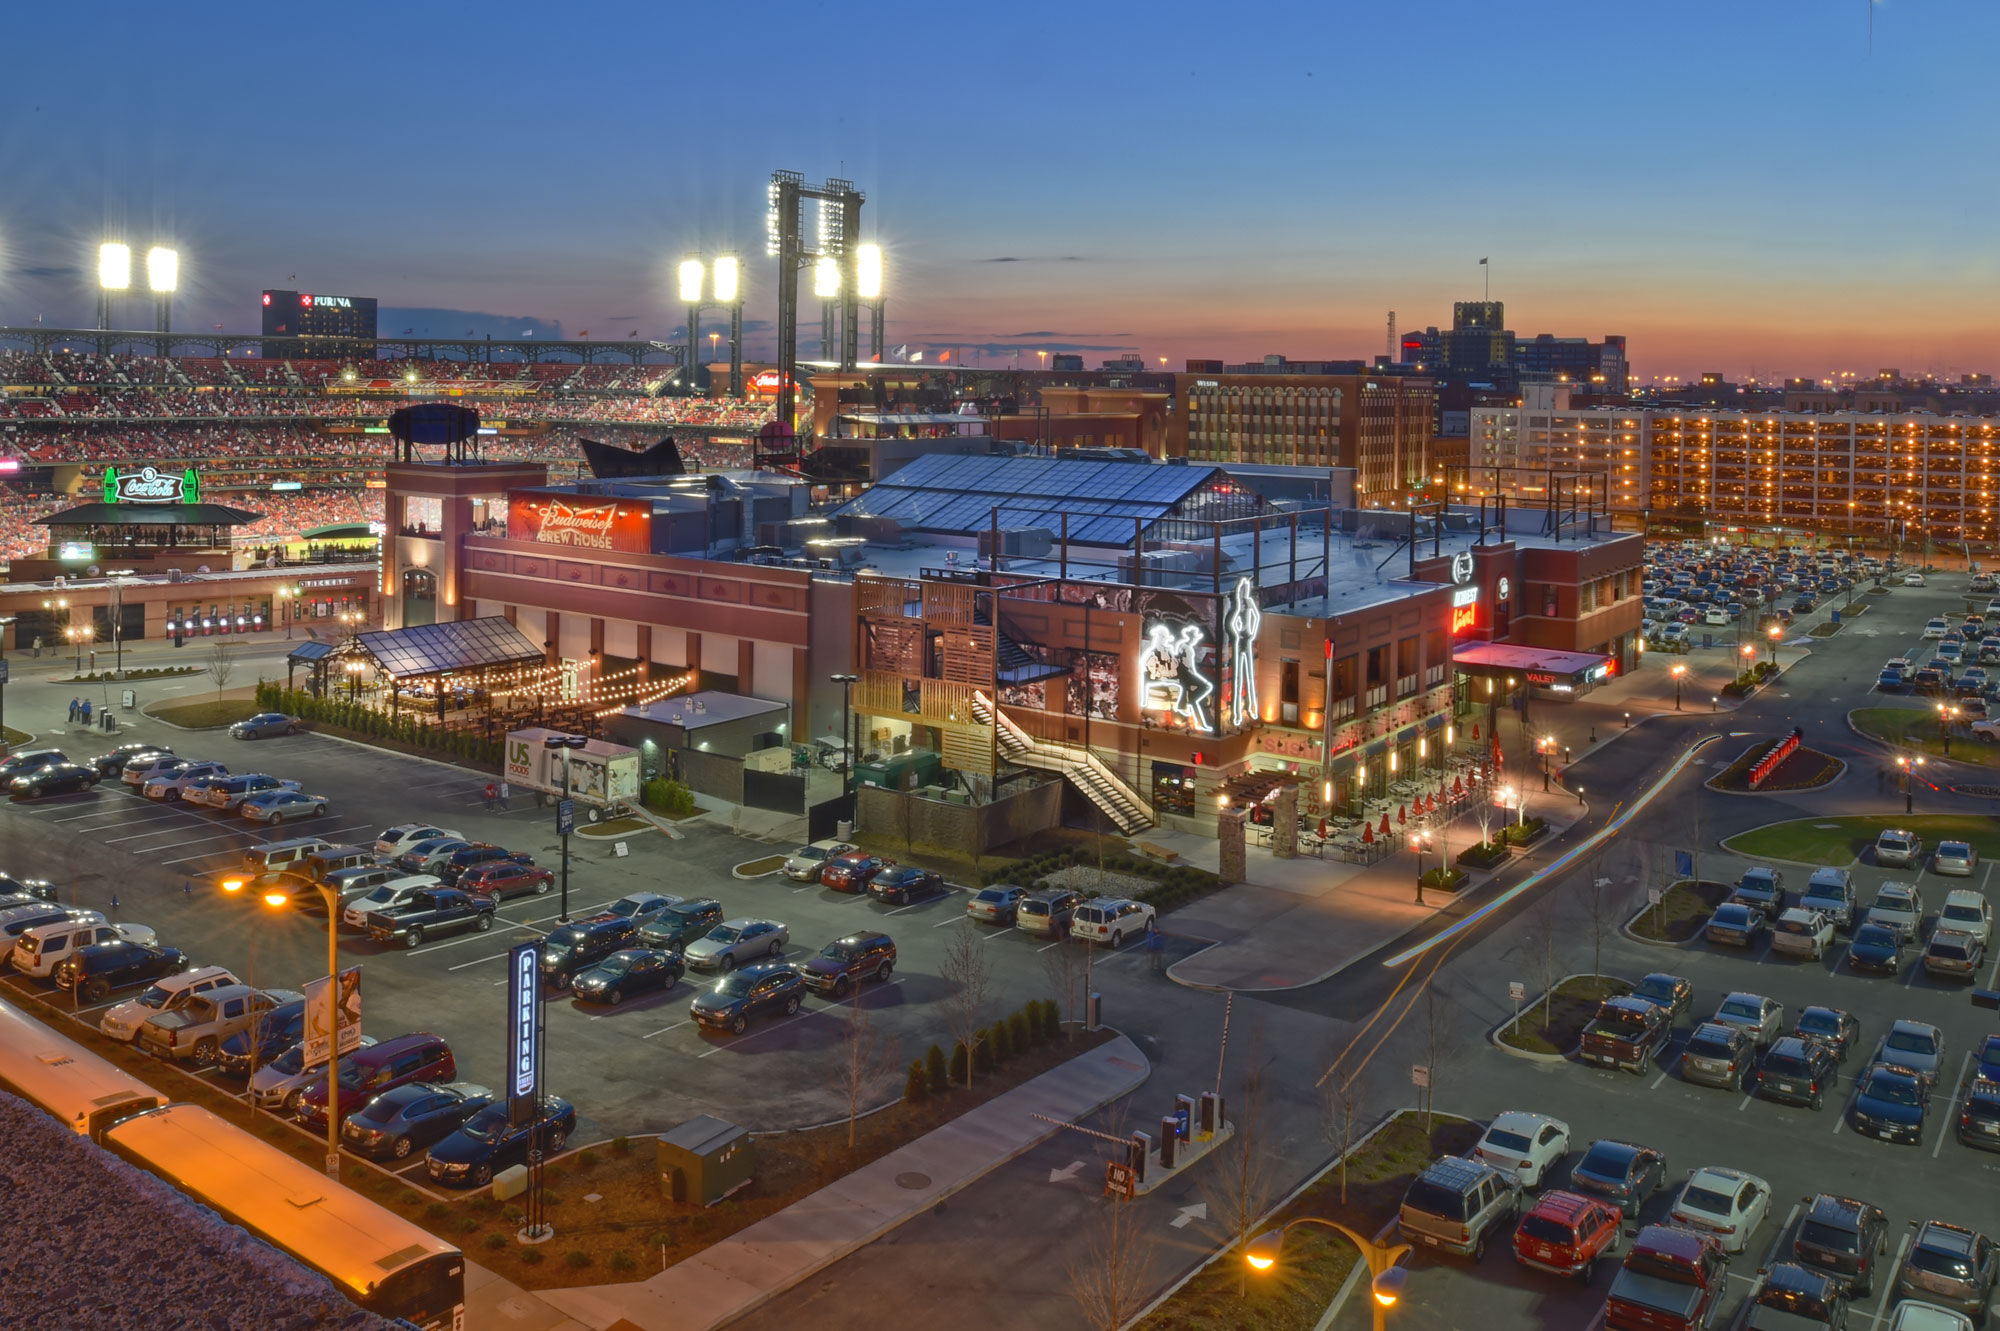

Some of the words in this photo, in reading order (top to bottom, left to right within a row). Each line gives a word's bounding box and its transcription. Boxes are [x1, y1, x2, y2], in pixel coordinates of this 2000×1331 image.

[314, 297, 351, 307] PURINA
[539, 507, 613, 529] Budweiser
[540, 530, 571, 543] BREW
[574, 533, 612, 549] HOUSE
[1526, 673, 1556, 683] VALET
[509, 763, 529, 776] FOODS
[521, 956, 531, 1072] PARKING
